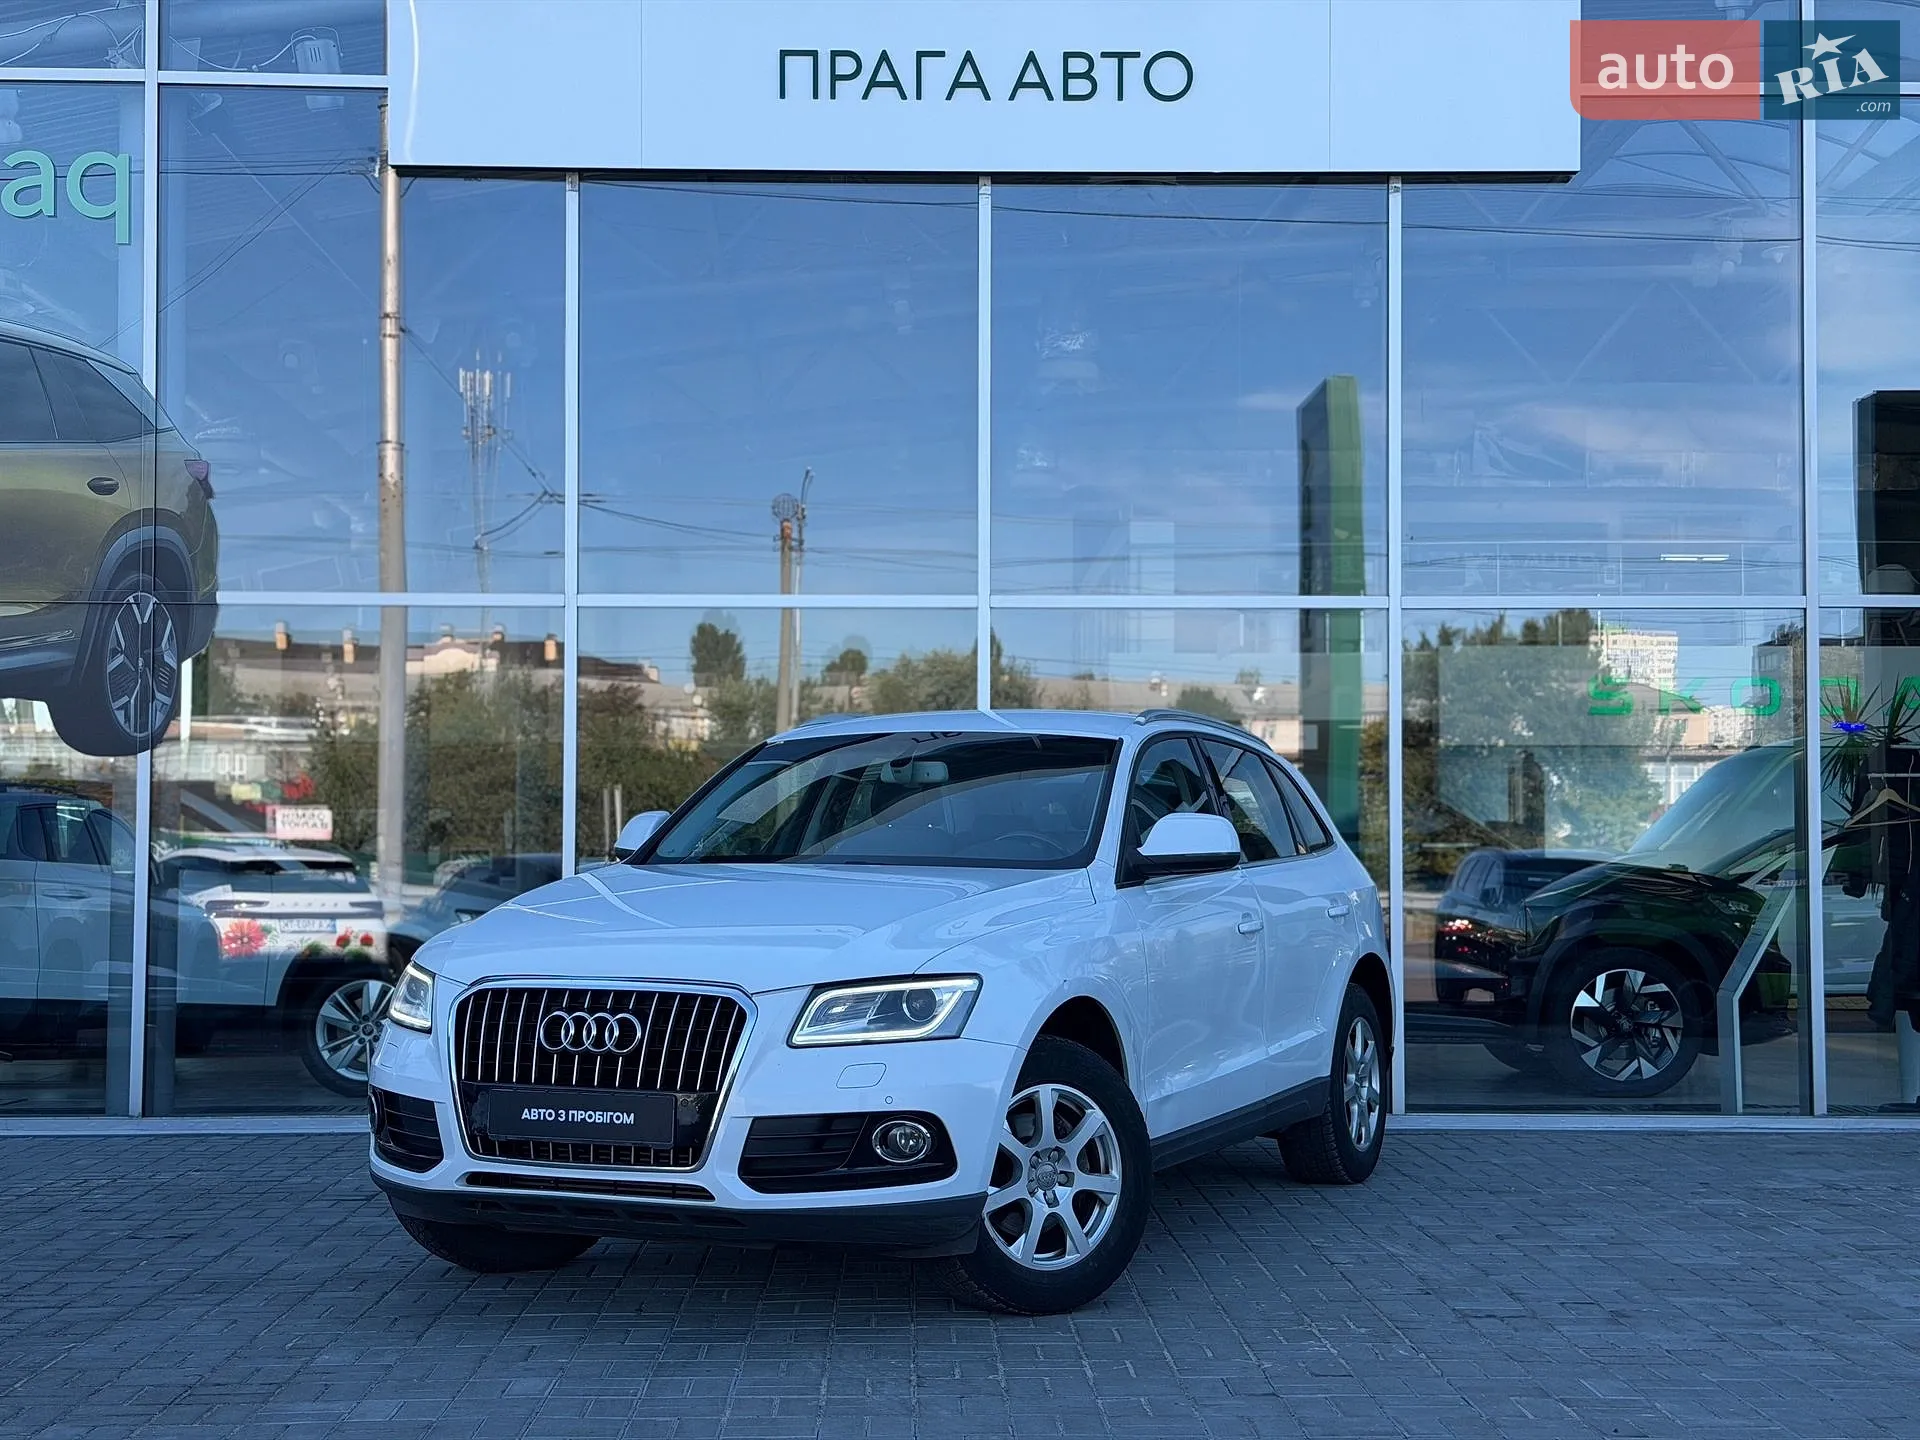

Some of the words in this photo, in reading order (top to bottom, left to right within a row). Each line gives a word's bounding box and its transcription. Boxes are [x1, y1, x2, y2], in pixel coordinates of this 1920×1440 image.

[778, 48, 993, 102] ПРАГА
[1007, 49, 1194, 103] АВТО
[520, 1107, 556, 1121] АВТО
[568, 1109, 635, 1125] ПРОБІГОМ
